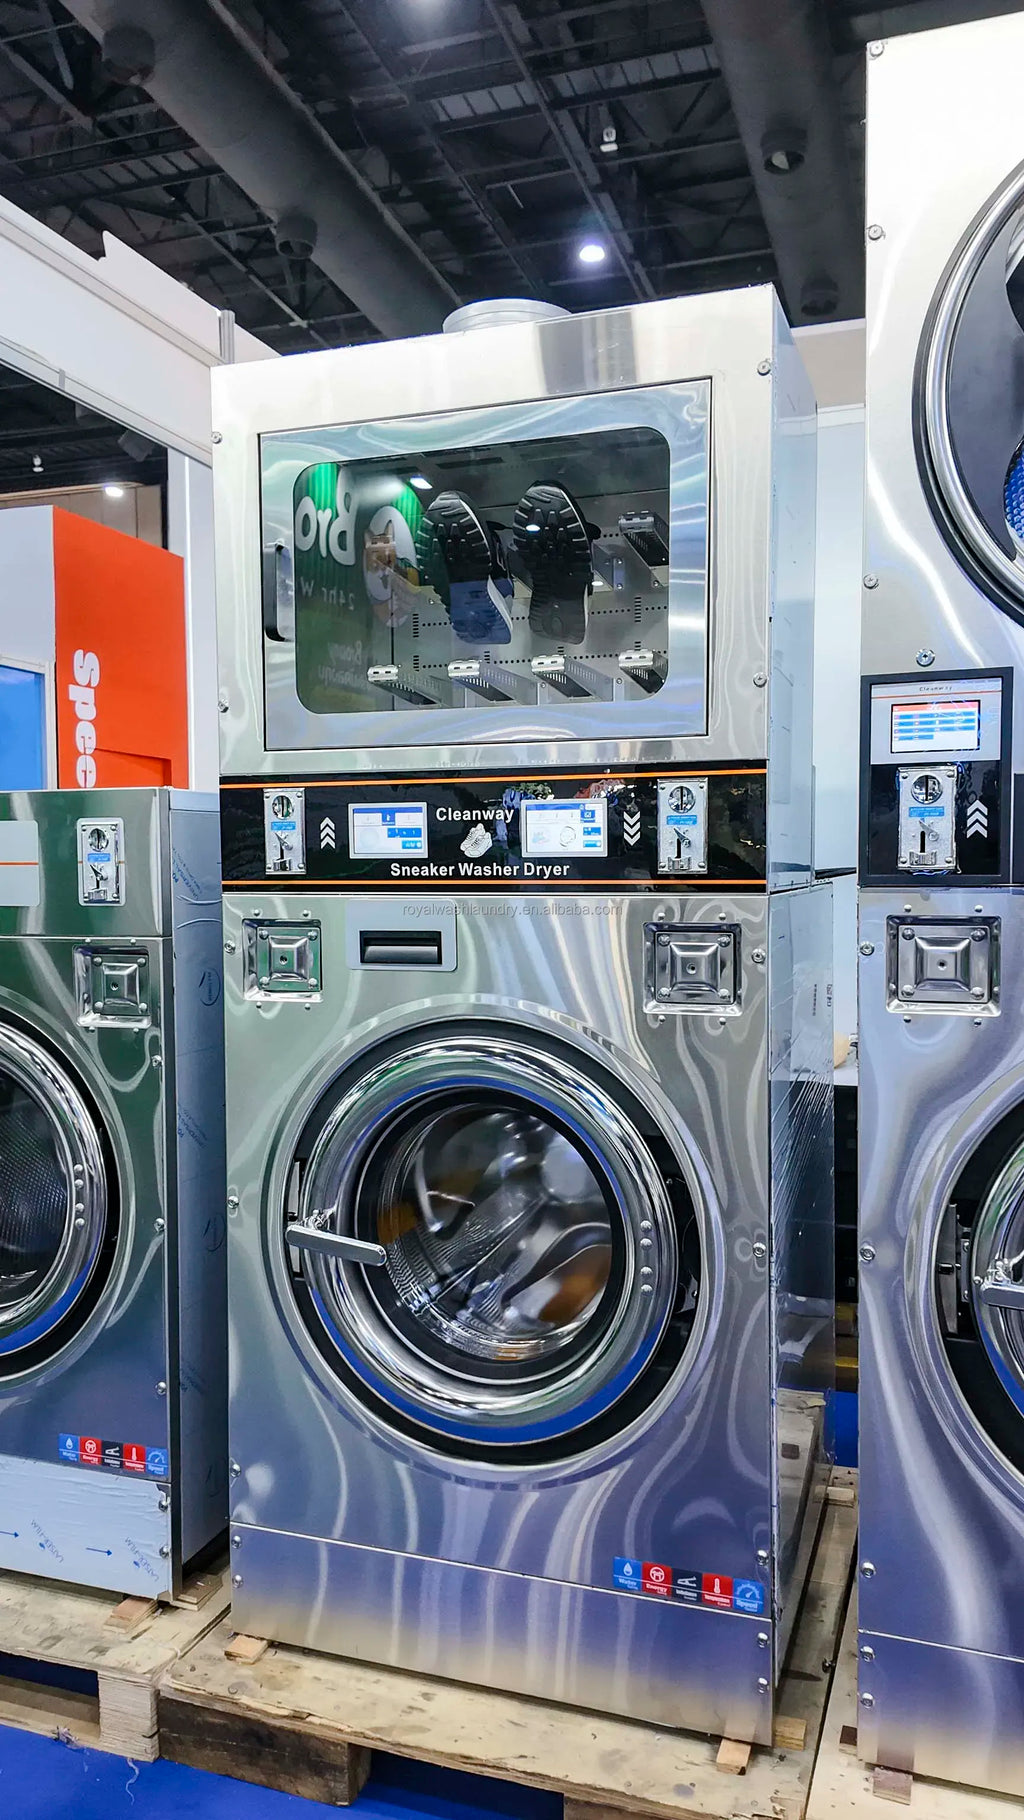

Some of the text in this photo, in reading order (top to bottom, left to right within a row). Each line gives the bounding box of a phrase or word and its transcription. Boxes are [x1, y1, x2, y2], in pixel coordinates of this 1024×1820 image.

[436, 807, 515, 824] Cleanway
[390, 863, 570, 880] Sneaker Washer Dryer
